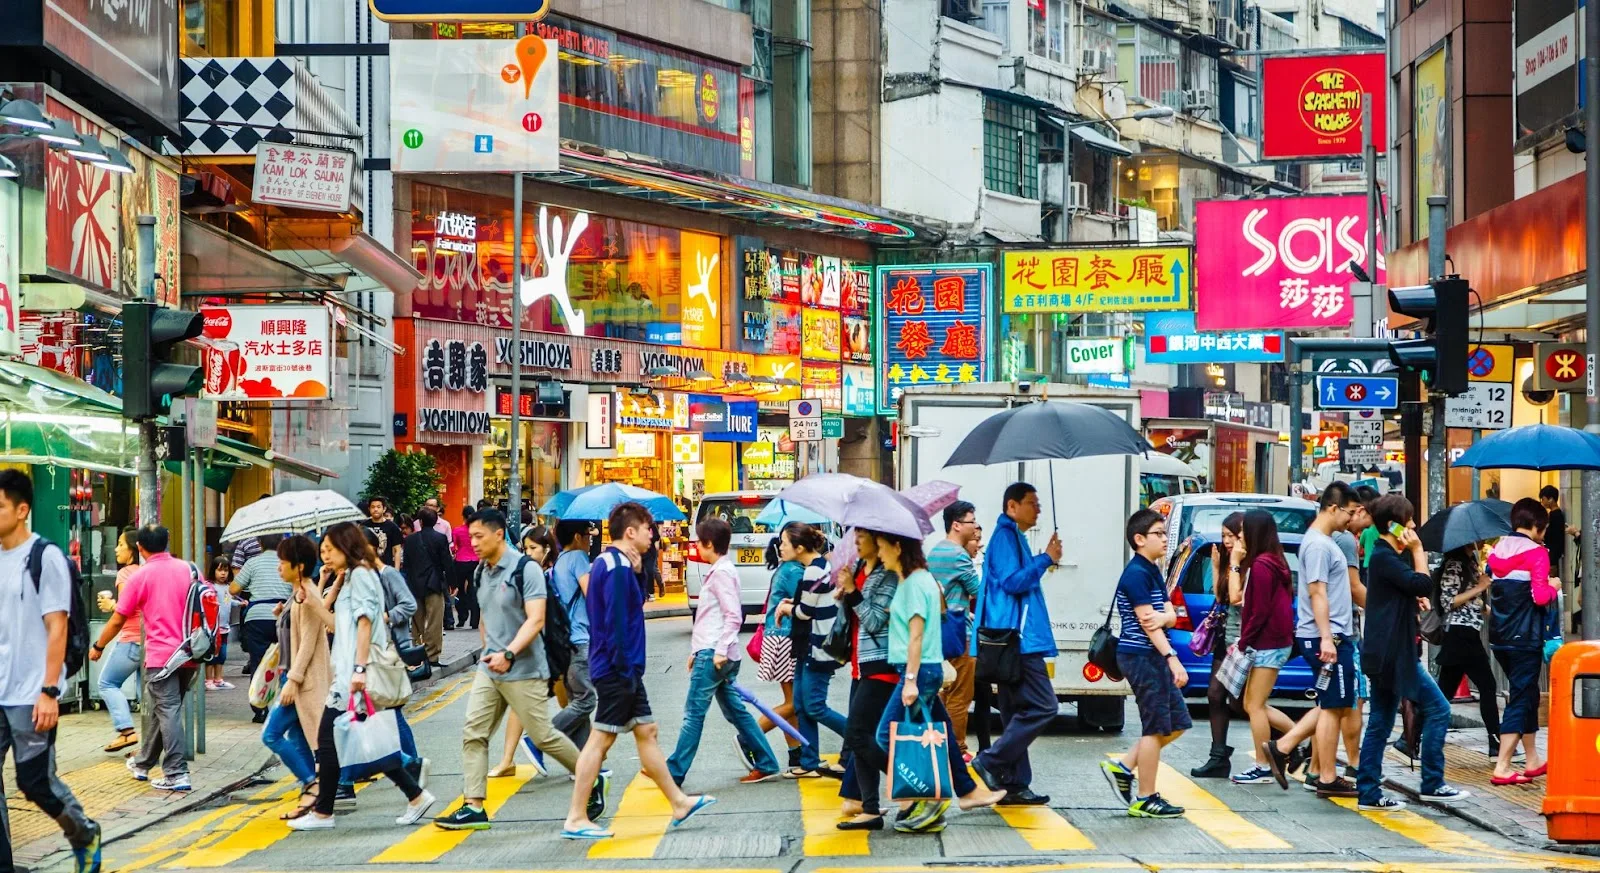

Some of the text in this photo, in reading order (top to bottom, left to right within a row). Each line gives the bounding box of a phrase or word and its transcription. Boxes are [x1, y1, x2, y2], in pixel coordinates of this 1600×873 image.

[582, 35, 608, 59] HOUSE
[1525, 57, 1537, 77] Shop
[1316, 72, 1346, 90] THE
[1304, 88, 1361, 112] SPAGHETTI
[1314, 111, 1353, 132] HOUSE
[262, 163, 344, 183] KAM LOK SAUNA
[437, 211, 476, 240] 大快活
[1012, 254, 1168, 290] 花園餐廳
[887, 276, 965, 316] 花園
[1013, 294, 1071, 308] 金百利商場
[1075, 293, 1094, 306] 4/F
[1279, 277, 1345, 318] 莎莎
[260, 319, 307, 336] 順興隆
[244, 340, 322, 356] 汽水士多店
[897, 319, 979, 359] 餐廳
[1168, 333, 1276, 351] 銀河中西大藥
[1070, 344, 1115, 363] Cover
[422, 338, 488, 393] 吉野家
[1488, 387, 1506, 401] 12
[420, 408, 492, 434] YOSHINOYA
[793, 420, 804, 428] 24
[1487, 409, 1504, 423] 12
[797, 429, 816, 438] 全日
[1370, 422, 1381, 431] 12
[1370, 435, 1381, 444] 12
[740, 555, 760, 563] 870
[743, 549, 756, 557] GV
[1056, 622, 1068, 630] HK
[1079, 622, 1099, 630] 2760
[897, 762, 930, 794] SATAMI
